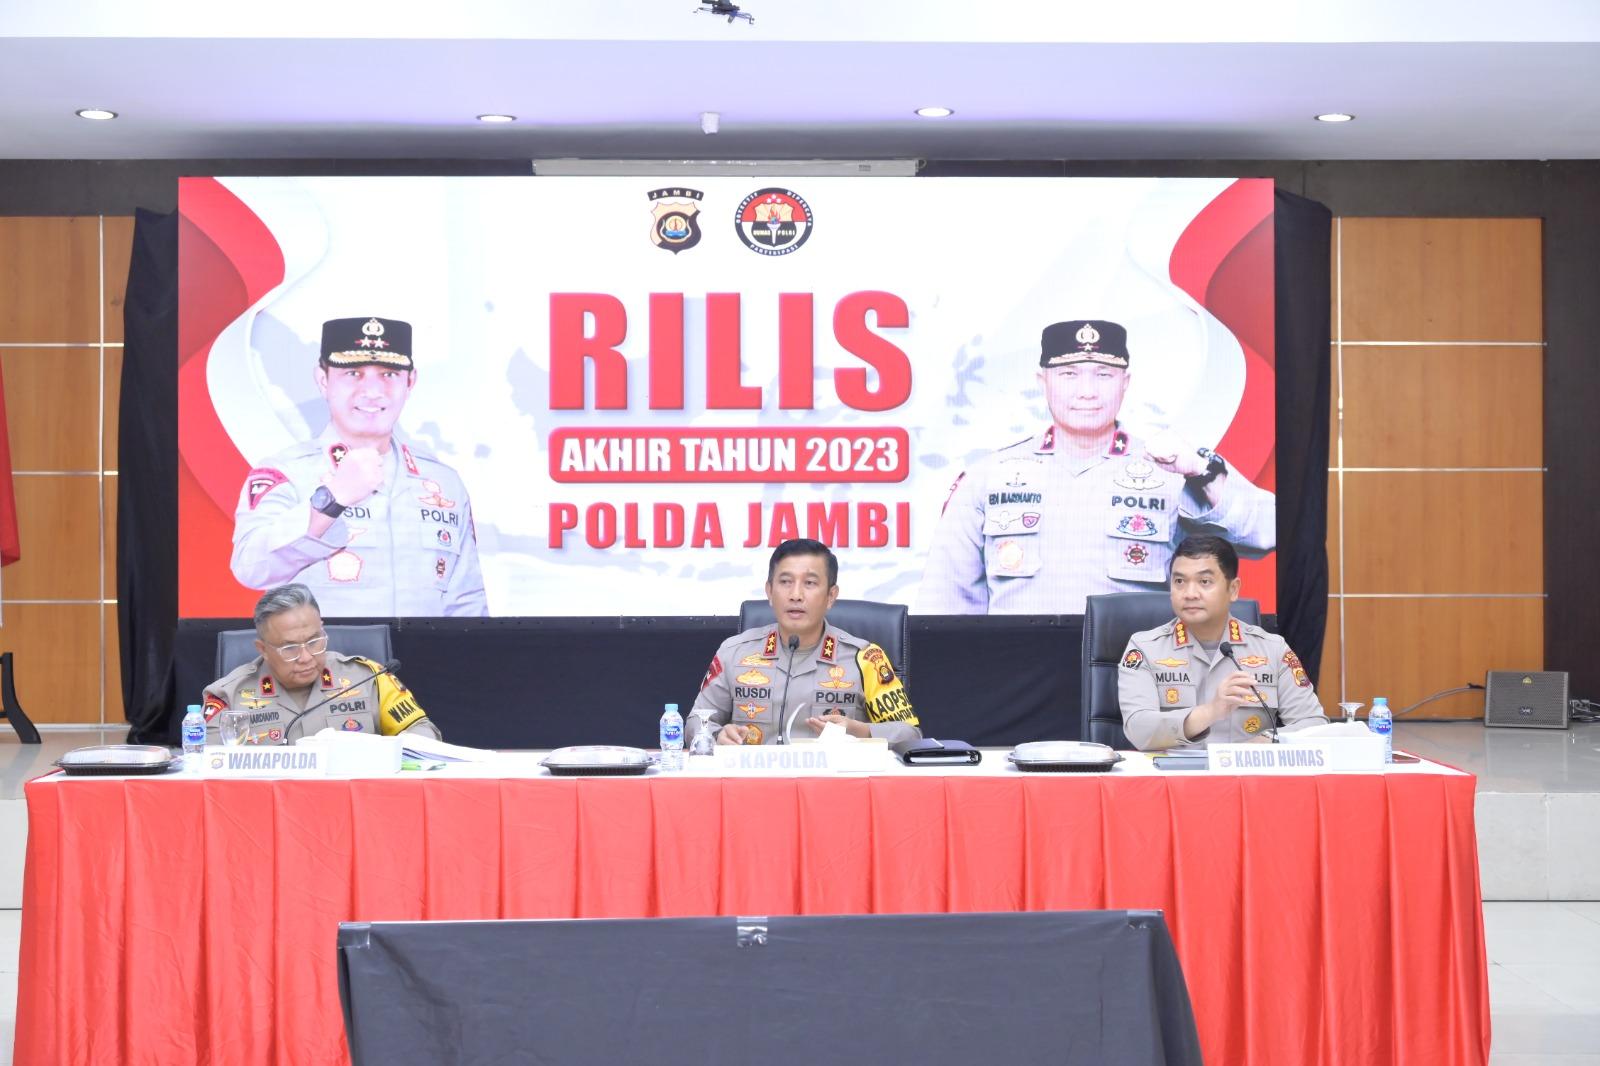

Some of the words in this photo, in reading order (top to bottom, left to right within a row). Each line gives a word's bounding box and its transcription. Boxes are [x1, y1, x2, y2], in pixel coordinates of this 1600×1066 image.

[652, 189, 700, 199] JAMBI
[777, 229, 796, 237] POLRI
[549, 290, 912, 412] RILIS
[560, 438, 671, 472] AKHIR
[680, 438, 796, 472] TAHUN
[806, 437, 899, 472] 2023
[1111, 495, 1166, 511] POLRI
[343, 506, 371, 519] SDI
[420, 508, 459, 526] POLRI
[549, 502, 725, 549] POLDA
[743, 502, 910, 549] JAMBI
[1155, 672, 1191, 683] MULIA
[1254, 673, 1273, 684] LRI
[735, 687, 771, 699] RUSDI
[815, 692, 856, 704] POLRI
[329, 701, 366, 713] POLRI
[388, 696, 418, 723] WAKA
[865, 687, 910, 721] KAOPS
[228, 752, 317, 770] WAKAPOLDA
[740, 751, 828, 768] KAPOLDA
[1234, 750, 1275, 768] KABID
[1277, 749, 1325, 767] HUMAS
